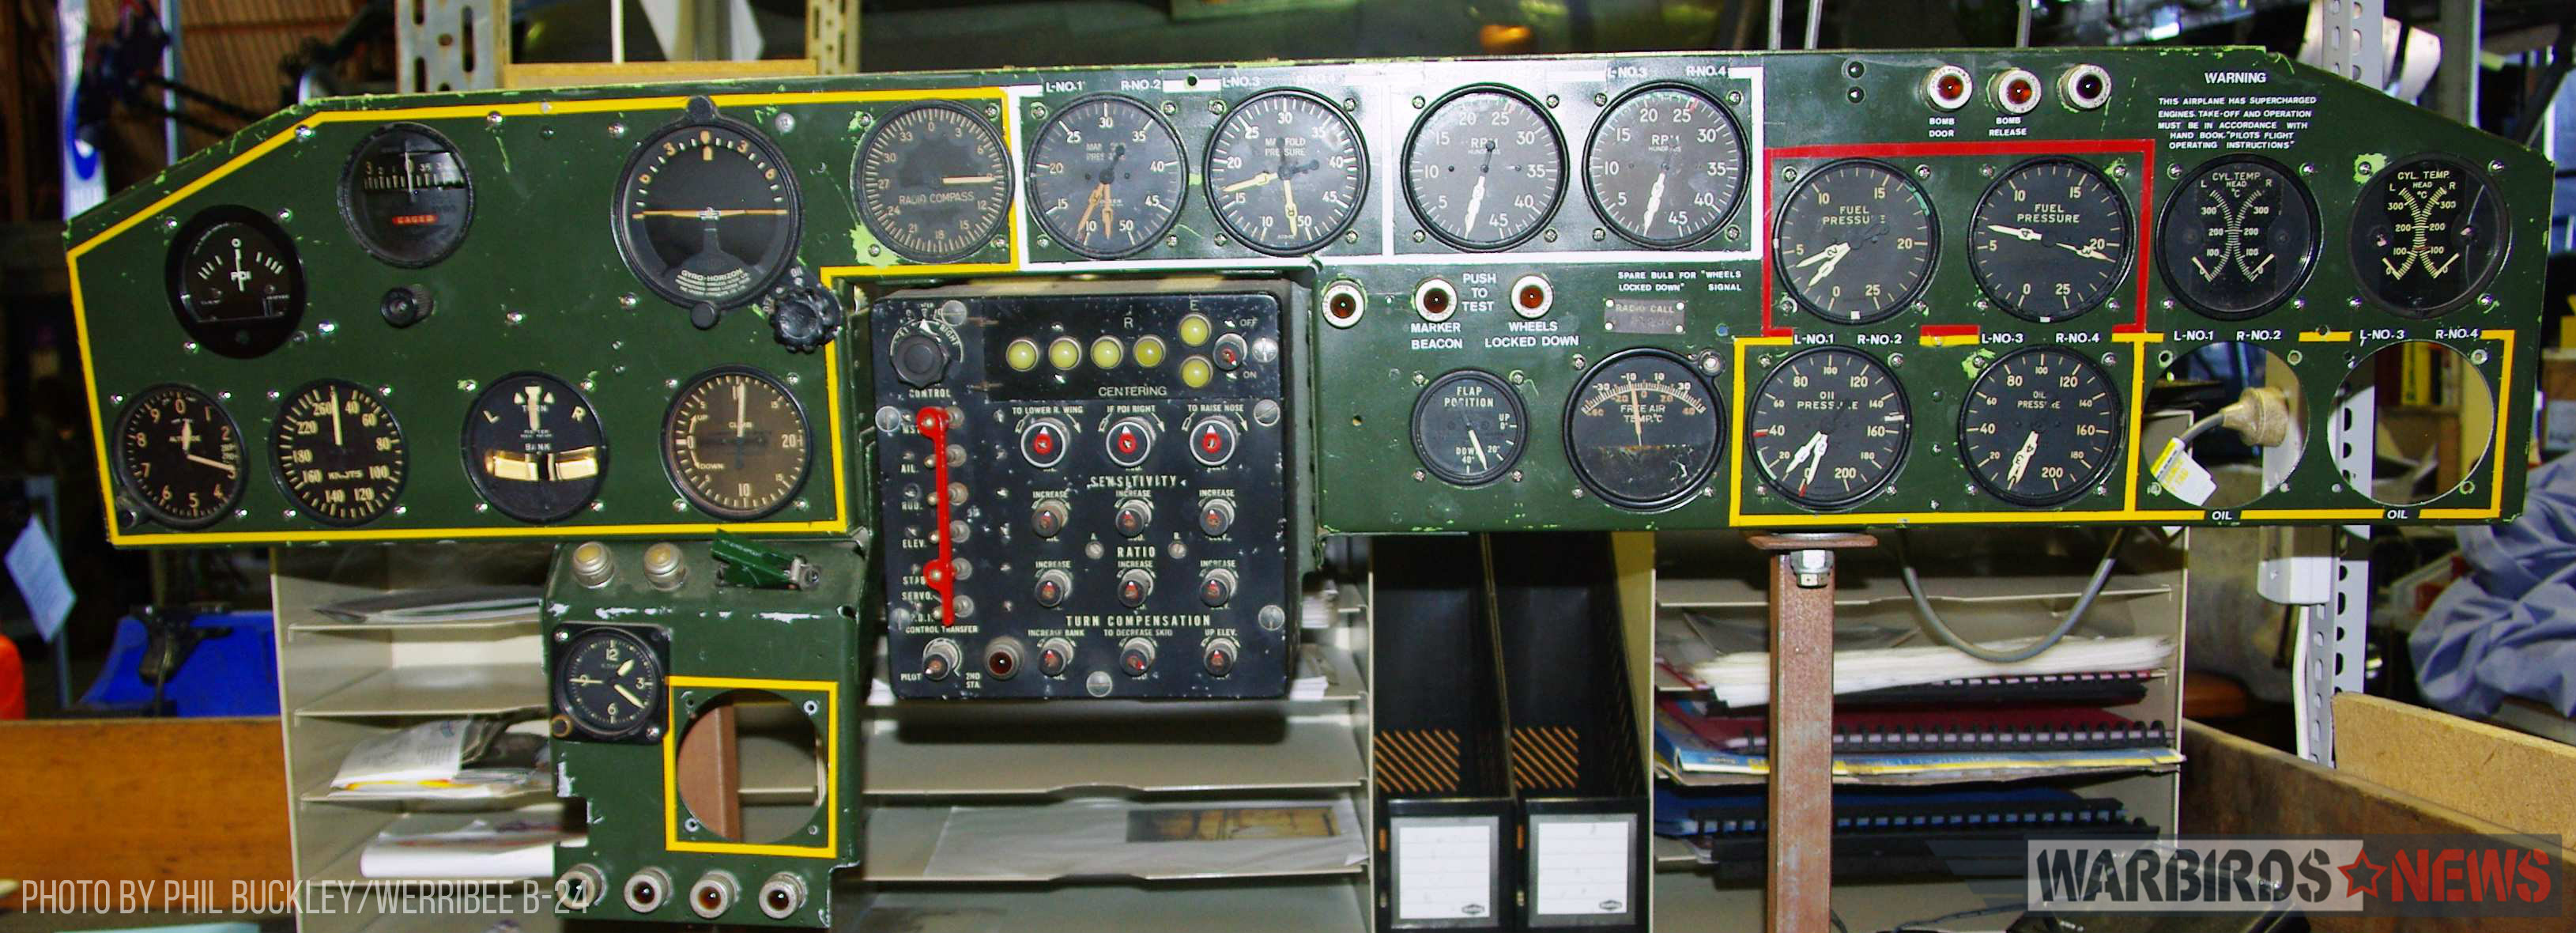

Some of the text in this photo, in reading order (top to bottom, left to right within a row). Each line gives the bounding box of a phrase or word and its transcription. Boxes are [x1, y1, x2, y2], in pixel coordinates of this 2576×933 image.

[1607, 66, 1726, 77] L-NO.3 R-NO.4
[2204, 73, 2267, 84] WARNING
[1121, 80, 1161, 90] R-NO.2
[1099, 117, 1113, 128] 30
[1278, 112, 1292, 124] 30
[1492, 111, 1509, 125] 25
[1697, 129, 1716, 142] 30
[1151, 161, 1164, 172] 40
[1527, 164, 1545, 178] 35
[1605, 161, 1620, 175] 10
[878, 179, 889, 188] 27
[930, 191, 974, 203] COMPASS
[977, 201, 986, 210] 12
[1839, 206, 1869, 214] FUEL
[2035, 204, 2064, 213] FUEL
[1823, 215, 1886, 225] PRESSUE
[2017, 214, 2080, 223] PRESSURE
[1463, 274, 1496, 284] PUSH
[1471, 288, 1488, 297] TO
[2056, 284, 2071, 295] 25
[1190, 300, 1198, 311] E
[1462, 301, 1494, 312] TEST
[1650, 304, 1674, 313] CALL
[1124, 317, 1133, 327] R
[1508, 322, 1558, 331] WHEELS
[1411, 323, 1461, 332] MARKER
[1794, 334, 1902, 345] L-NO.1 R-NO.2
[1982, 334, 2100, 343] L-NO.3 R-NO.4
[2174, 331, 2281, 341] L-NO.1 R-NO.2
[2360, 330, 2479, 339] L-NO.3 R-NO.4
[1411, 338, 1462, 349] BEACON
[1485, 336, 1579, 347] LOCKED DOWN
[1850, 377, 1868, 387] 120
[1099, 387, 1167, 396] CENTERING
[1457, 387, 1482, 395] FLAP
[1868, 426, 1885, 436] 160
[137, 432, 146, 448] 8
[375, 436, 391, 451] 80
[782, 434, 796, 448] 20
[369, 465, 390, 479] 100
[901, 464, 919, 473] AIL.
[2042, 467, 2063, 478] 200
[1090, 476, 1176, 487] SENSITIVITY
[2212, 511, 2232, 520] OIL
[2387, 509, 2408, 519] OIL
[903, 539, 926, 548] ELEV.
[1117, 546, 1156, 557] RATIO
[902, 592, 933, 601] SERVO.
[1065, 616, 1210, 626] TURN COMPENSATION
[606, 649, 618, 660] 12
